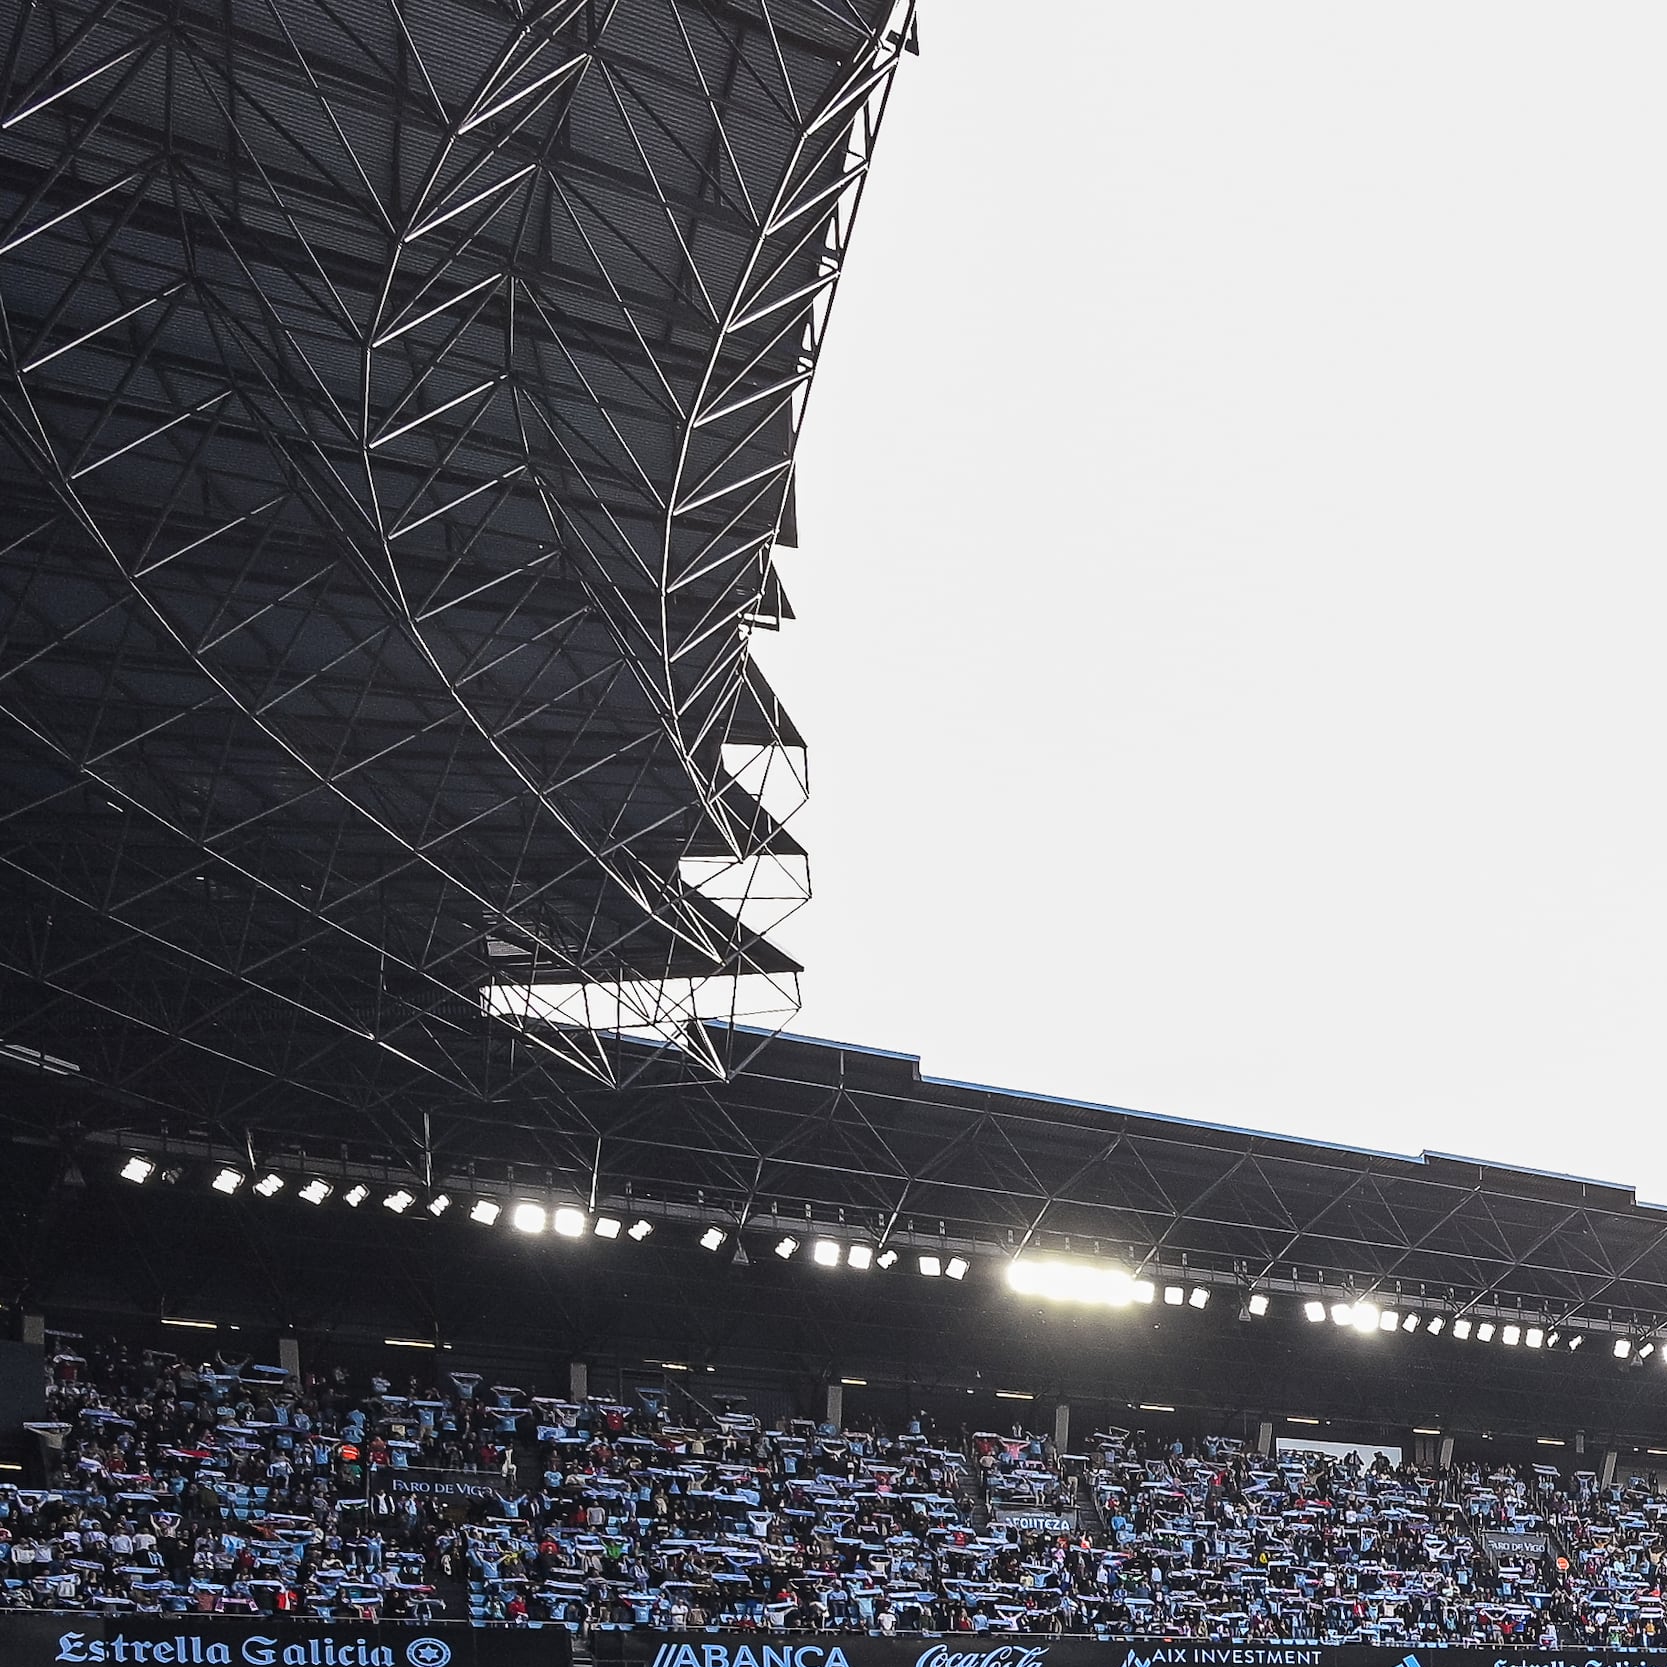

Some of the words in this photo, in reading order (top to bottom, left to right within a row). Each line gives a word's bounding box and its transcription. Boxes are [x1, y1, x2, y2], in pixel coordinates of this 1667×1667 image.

[393, 1480, 430, 1492] FARO
[435, 1483, 454, 1494] DE
[55, 1631, 232, 1663] Estrella
[242, 1635, 396, 1667] Galicia
[1152, 1649, 1187, 1664] AIX
[1194, 1649, 1323, 1666] INVESTMENT
